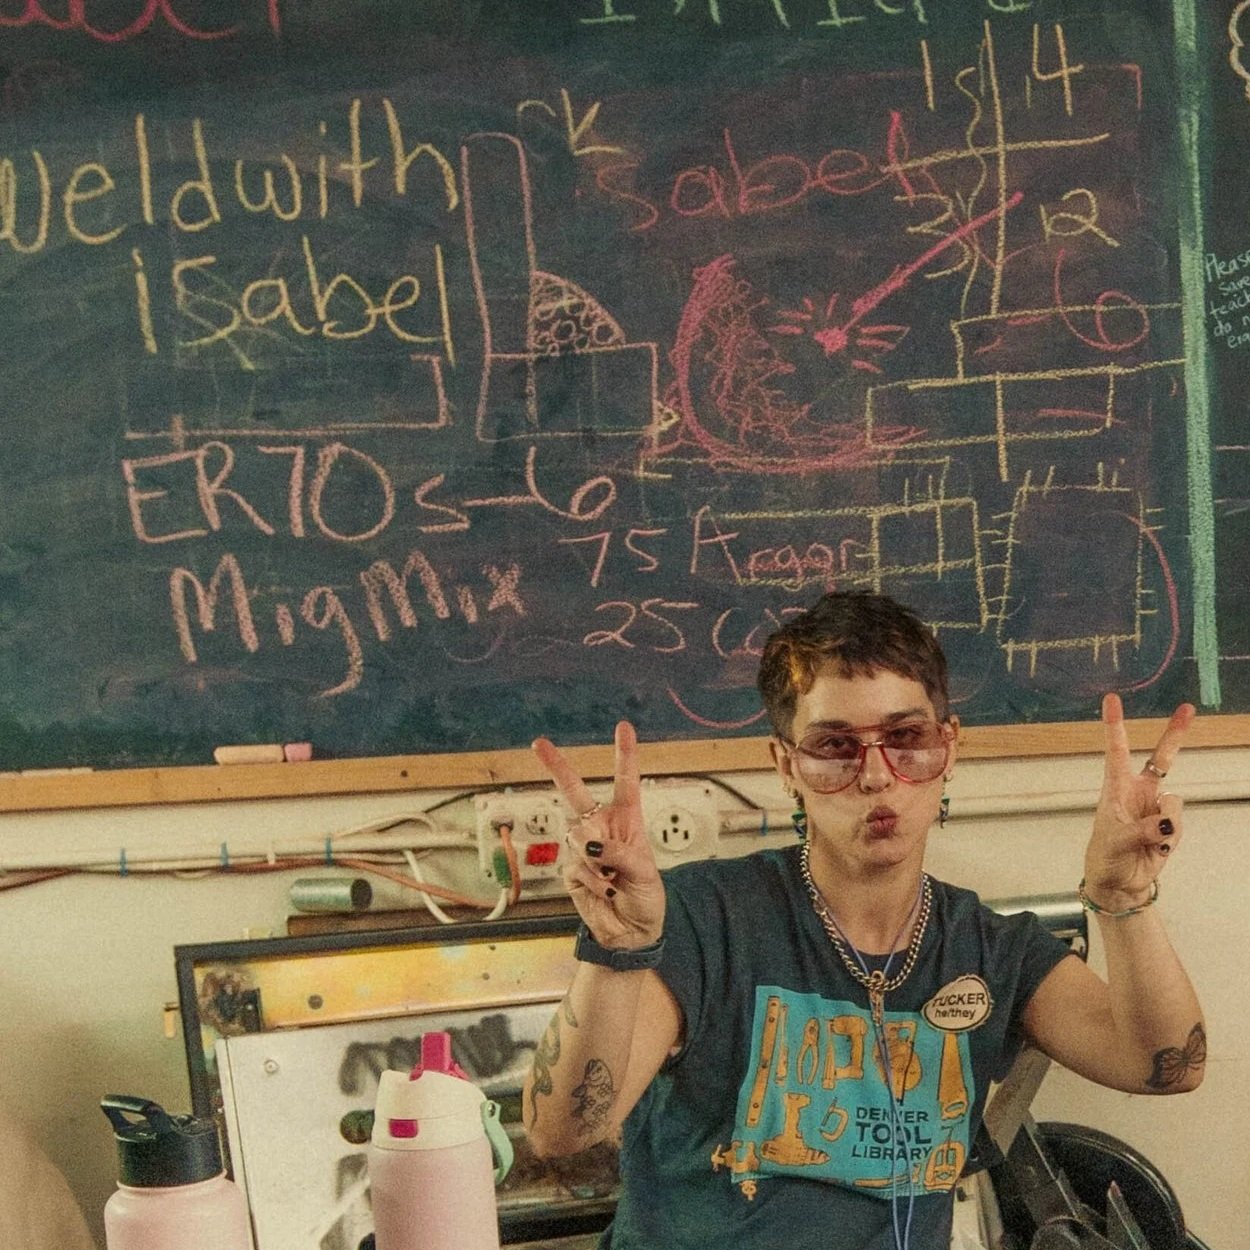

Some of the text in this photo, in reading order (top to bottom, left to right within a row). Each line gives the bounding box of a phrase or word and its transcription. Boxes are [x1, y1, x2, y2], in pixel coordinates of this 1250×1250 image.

[1213, 320, 1233, 337] do
[582, 598, 699, 653] 25
[931, 992, 986, 1008] TUCKER
[855, 1106, 929, 1123] DENVER
[854, 1122, 932, 1145] TOOL
[851, 1145, 933, 1161] LIBRARY
